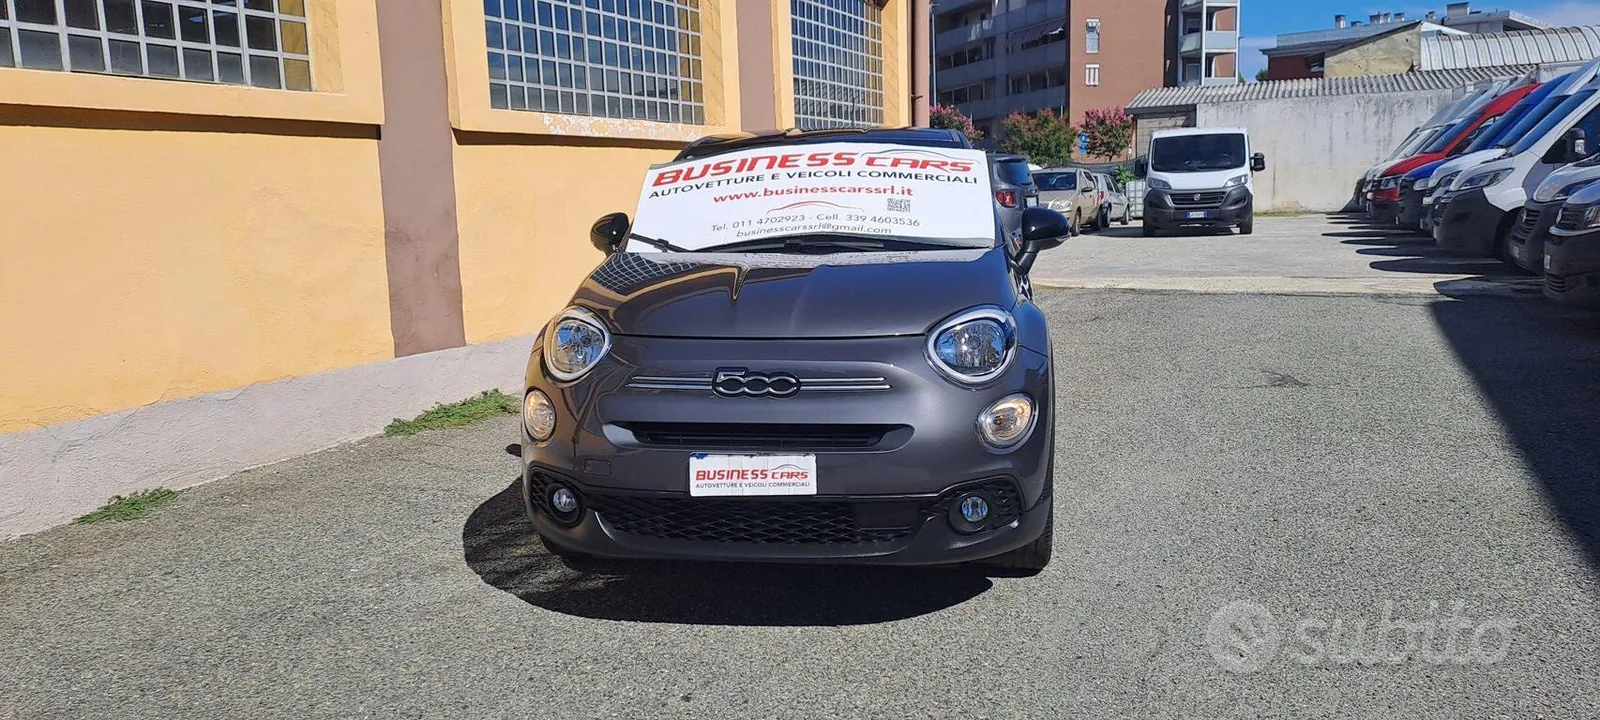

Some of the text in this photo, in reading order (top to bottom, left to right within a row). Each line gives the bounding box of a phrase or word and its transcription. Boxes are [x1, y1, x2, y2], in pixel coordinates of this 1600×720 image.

[652, 152, 974, 187] BUSINESS CARS
[649, 170, 978, 199] AUTOVETTURE E VEICOLI COMMERCIALI
[713, 185, 914, 203] www.businesscarssrl.it
[711, 223, 729, 232] Tel.
[732, 219, 752, 229] 011
[756, 214, 806, 225] 4702923
[816, 213, 841, 221] Cell.
[846, 214, 867, 222] 339
[870, 216, 921, 227] 4603536
[736, 222, 892, 238] businesscarssrl@gmail.com
[712, 367, 801, 398] 500
[695, 469, 809, 481] BUSINESS CARS
